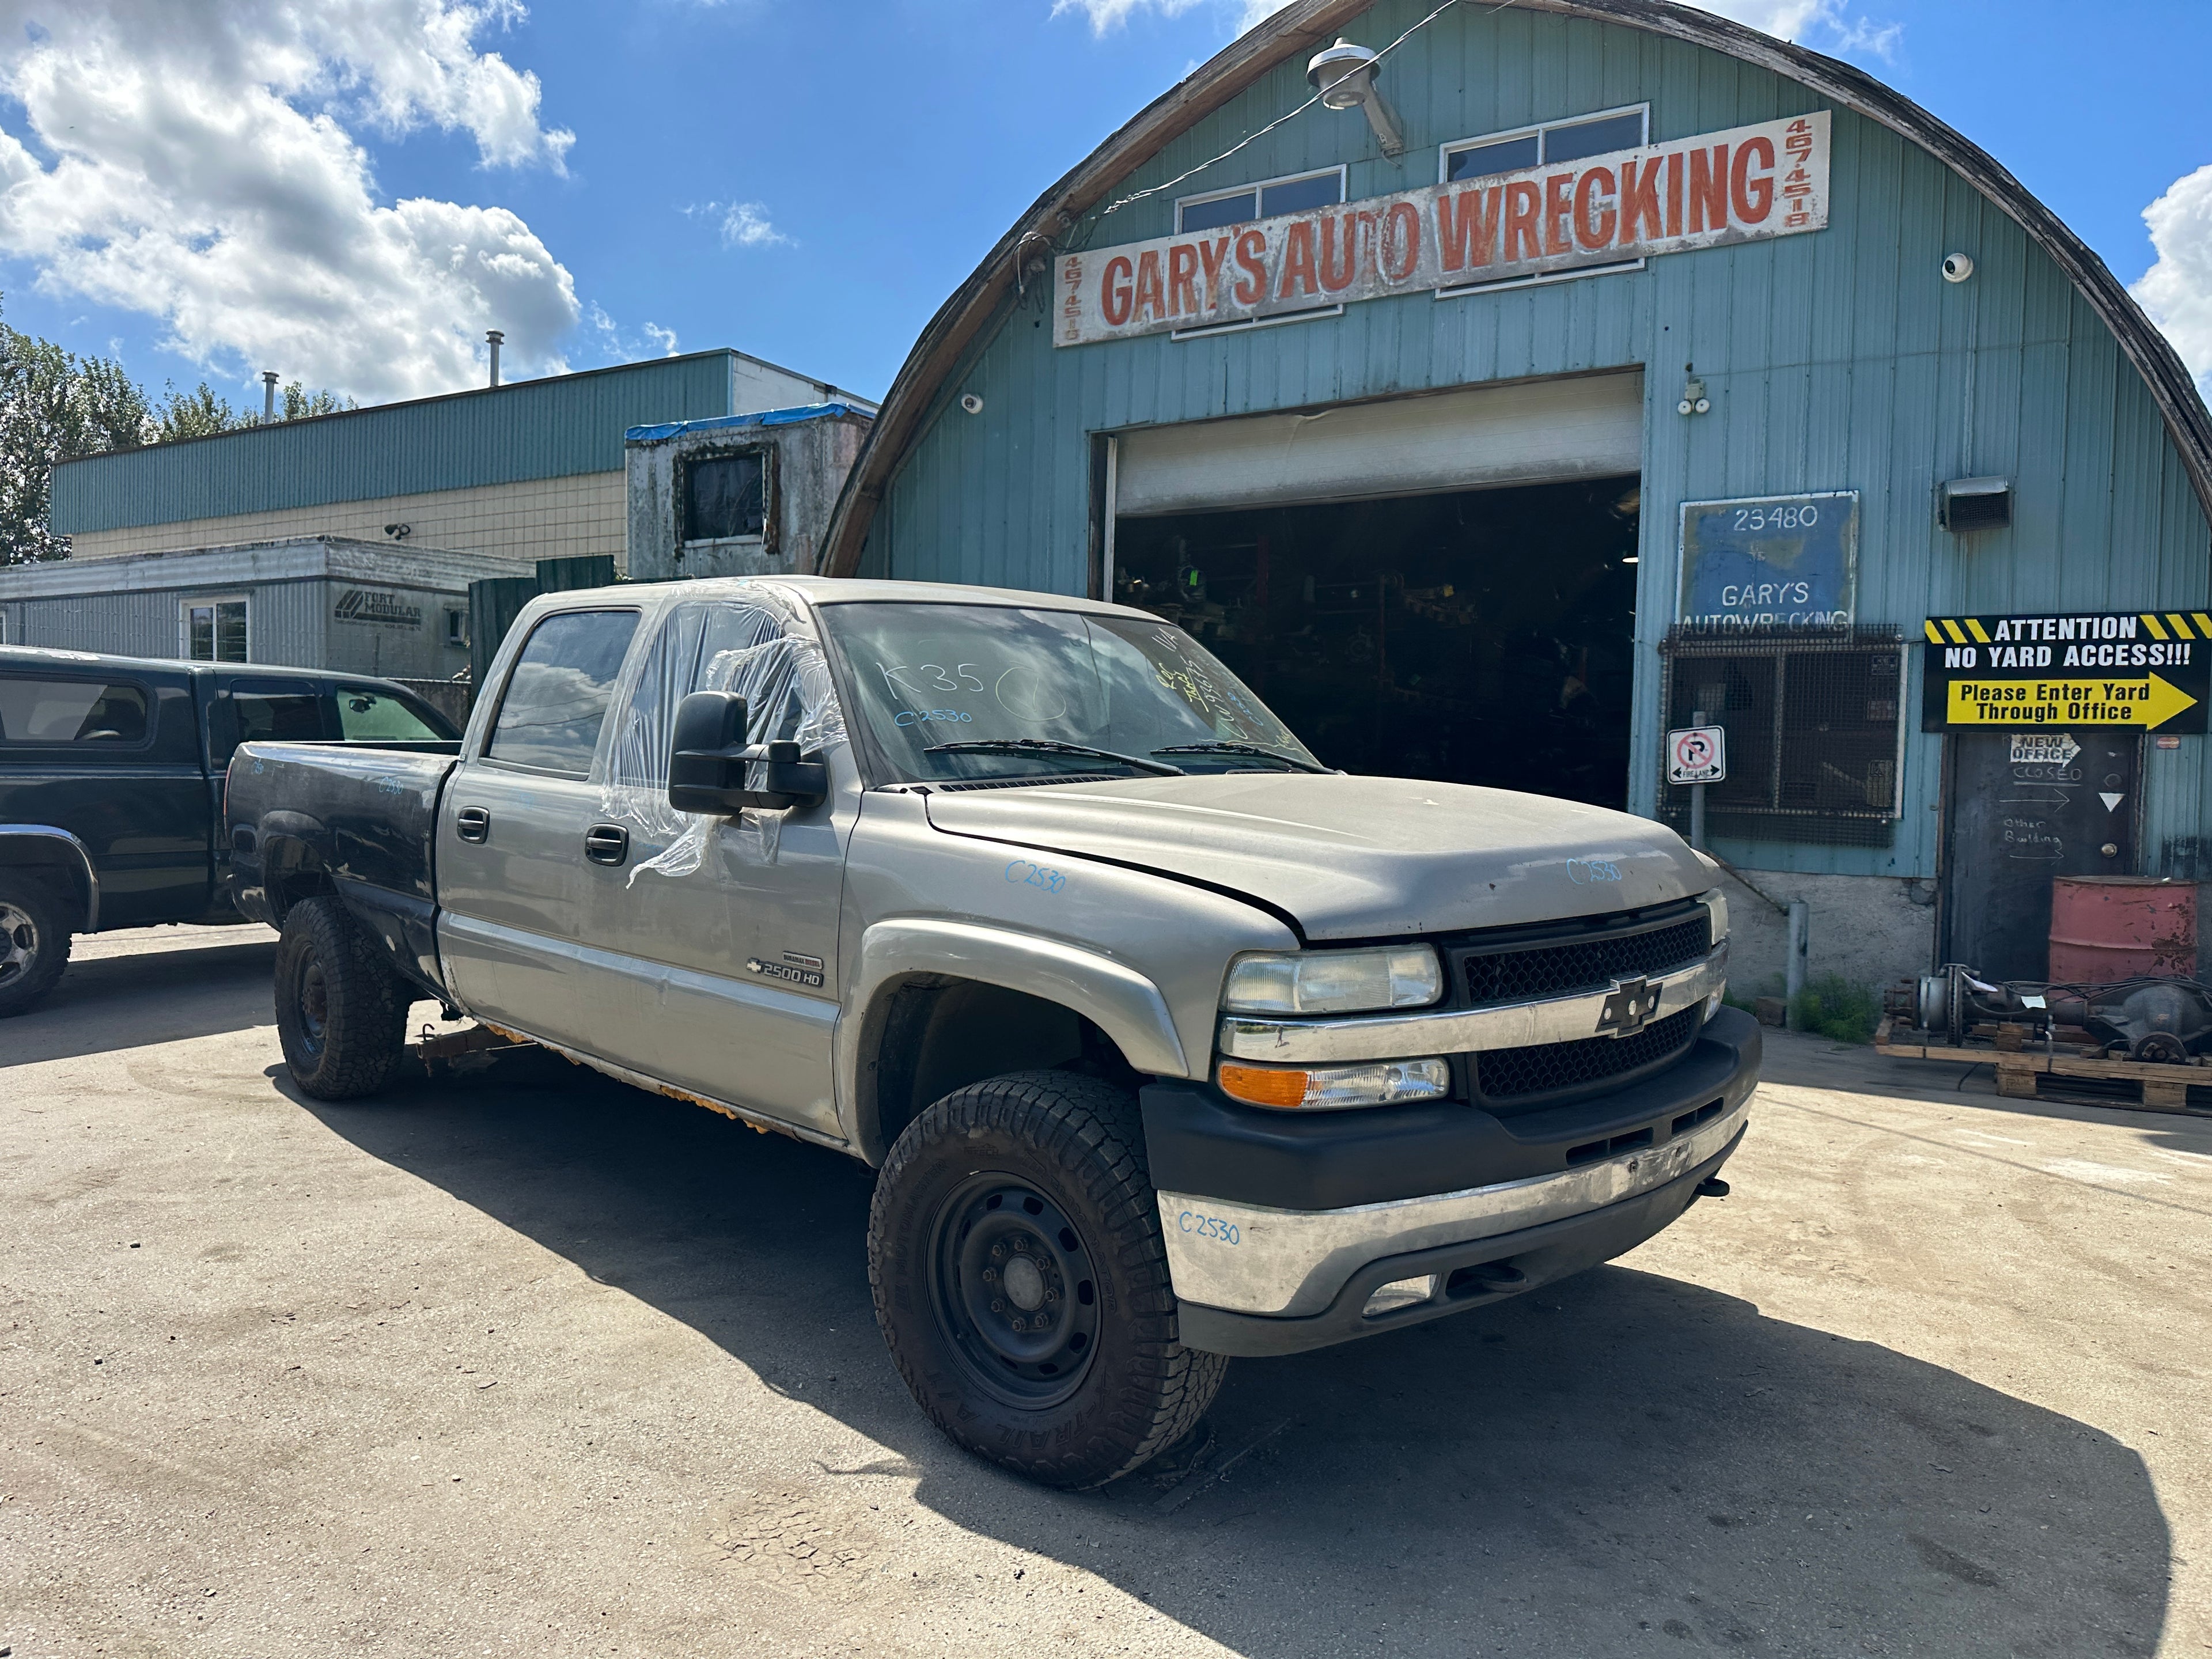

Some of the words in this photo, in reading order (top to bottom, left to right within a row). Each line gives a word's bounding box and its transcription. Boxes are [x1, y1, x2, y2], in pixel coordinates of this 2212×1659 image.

[1101, 225, 1267, 327] GARY'S
[1278, 202, 1421, 298] AUTO
[1438, 137, 1775, 271] WRECKING
[1733, 505, 1818, 531] 23480
[364, 591, 396, 604] FORT
[1722, 581, 1809, 607] GARY'S
[364, 603, 421, 618] MODULAR
[1994, 616, 2137, 642] ATTENTION
[1945, 646, 1976, 668] NO
[1988, 645, 2052, 668] YARD
[2063, 643, 2191, 666] ACCESS!!!
[1961, 684, 2027, 701] Please
[2036, 683, 2093, 701] Enter
[2103, 683, 2150, 700] Yard
[894, 709, 972, 726] C2530
[1976, 702, 2058, 722] Through
[2068, 702, 2132, 719] Office
[2012, 747, 2073, 759] OFFICE
[2021, 737, 2062, 748] NEW
[1005, 860, 1066, 893] C2530
[783, 955, 805, 964] DURAMAX
[805, 959, 821, 968] DIESEL
[763, 964, 801, 982] 2500
[804, 974, 820, 986] HD
[1179, 1211, 1240, 1245] C2530
